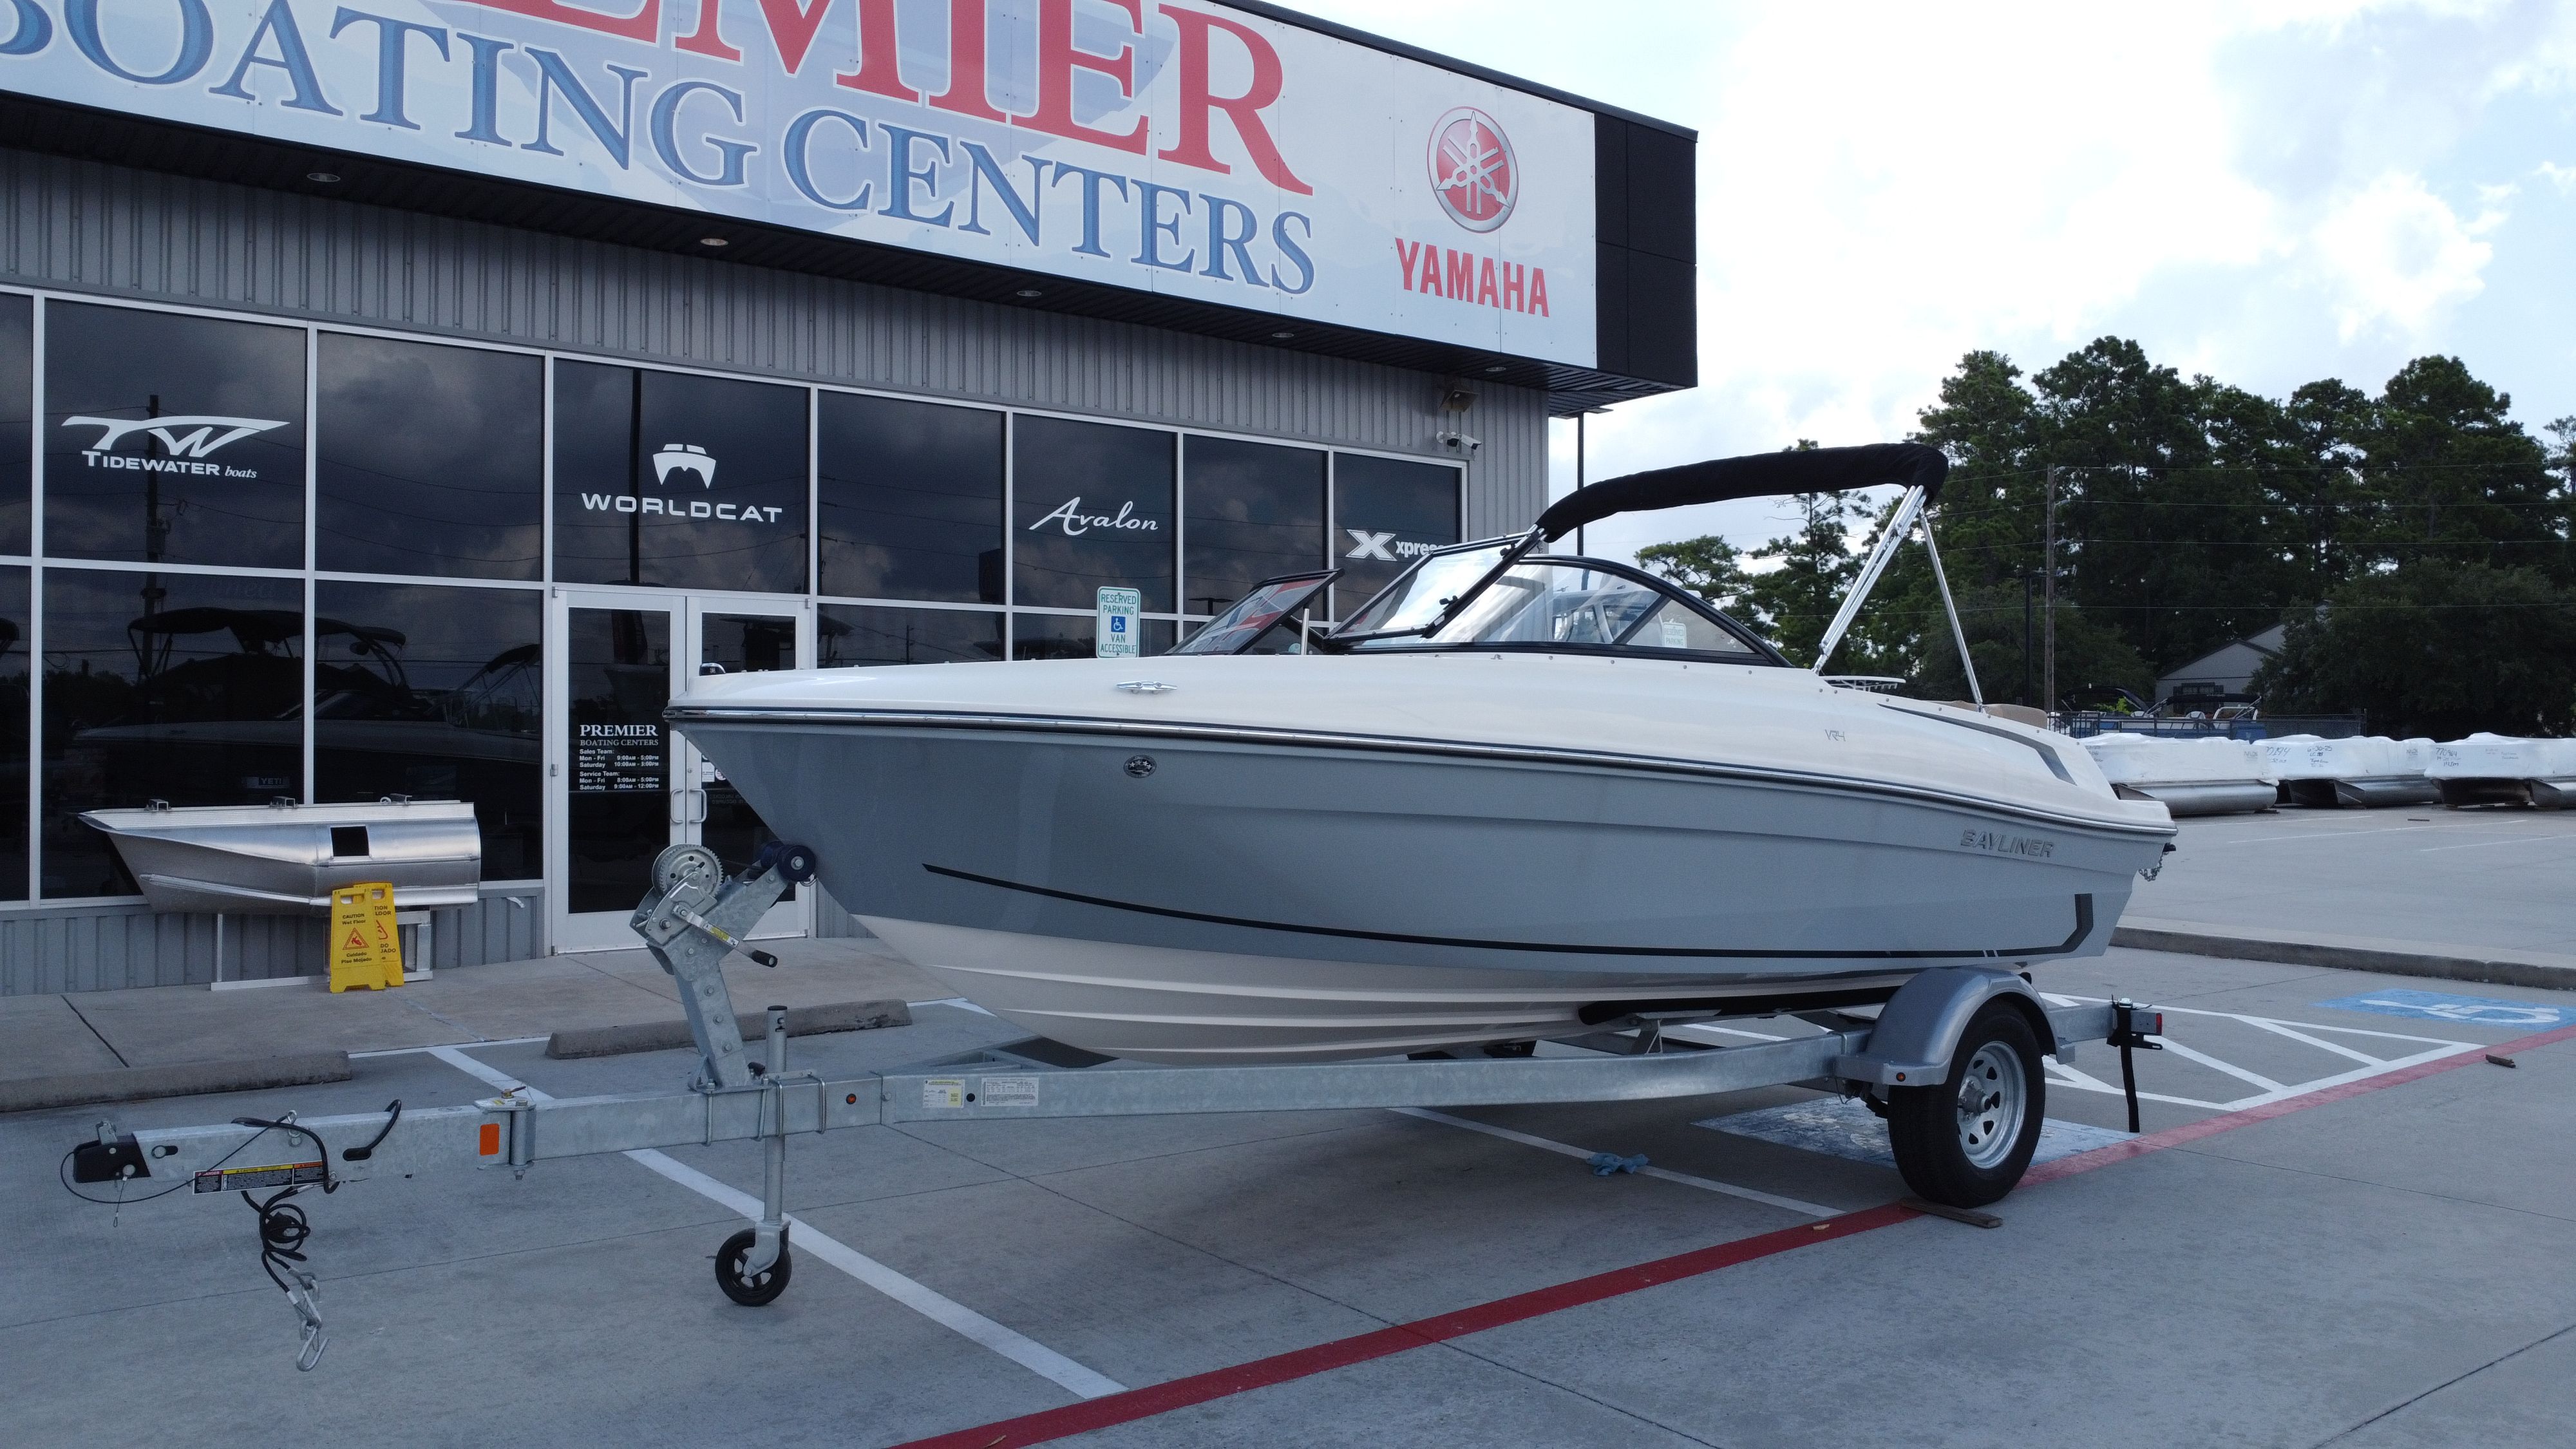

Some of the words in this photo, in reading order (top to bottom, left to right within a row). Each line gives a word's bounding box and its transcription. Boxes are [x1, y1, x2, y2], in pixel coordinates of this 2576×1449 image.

[0, 0, 757, 187] OATING
[783, 109, 1314, 294] CENTERS
[1395, 237, 1549, 317] YAMAHA
[82, 451, 220, 476] TIDEWATER
[225, 466, 257, 478] boats
[582, 493, 782, 522] WORLDCAT
[1028, 497, 1159, 536] Avalon
[1101, 594, 1137, 605] RESERVED
[1103, 605, 1134, 615] PARKING
[1100, 644, 1136, 654] ACCESSIBLE
[1111, 634, 1126, 643] VAN
[580, 724, 659, 736] PREMIER
[1960, 829, 2054, 858] BAYLINER
